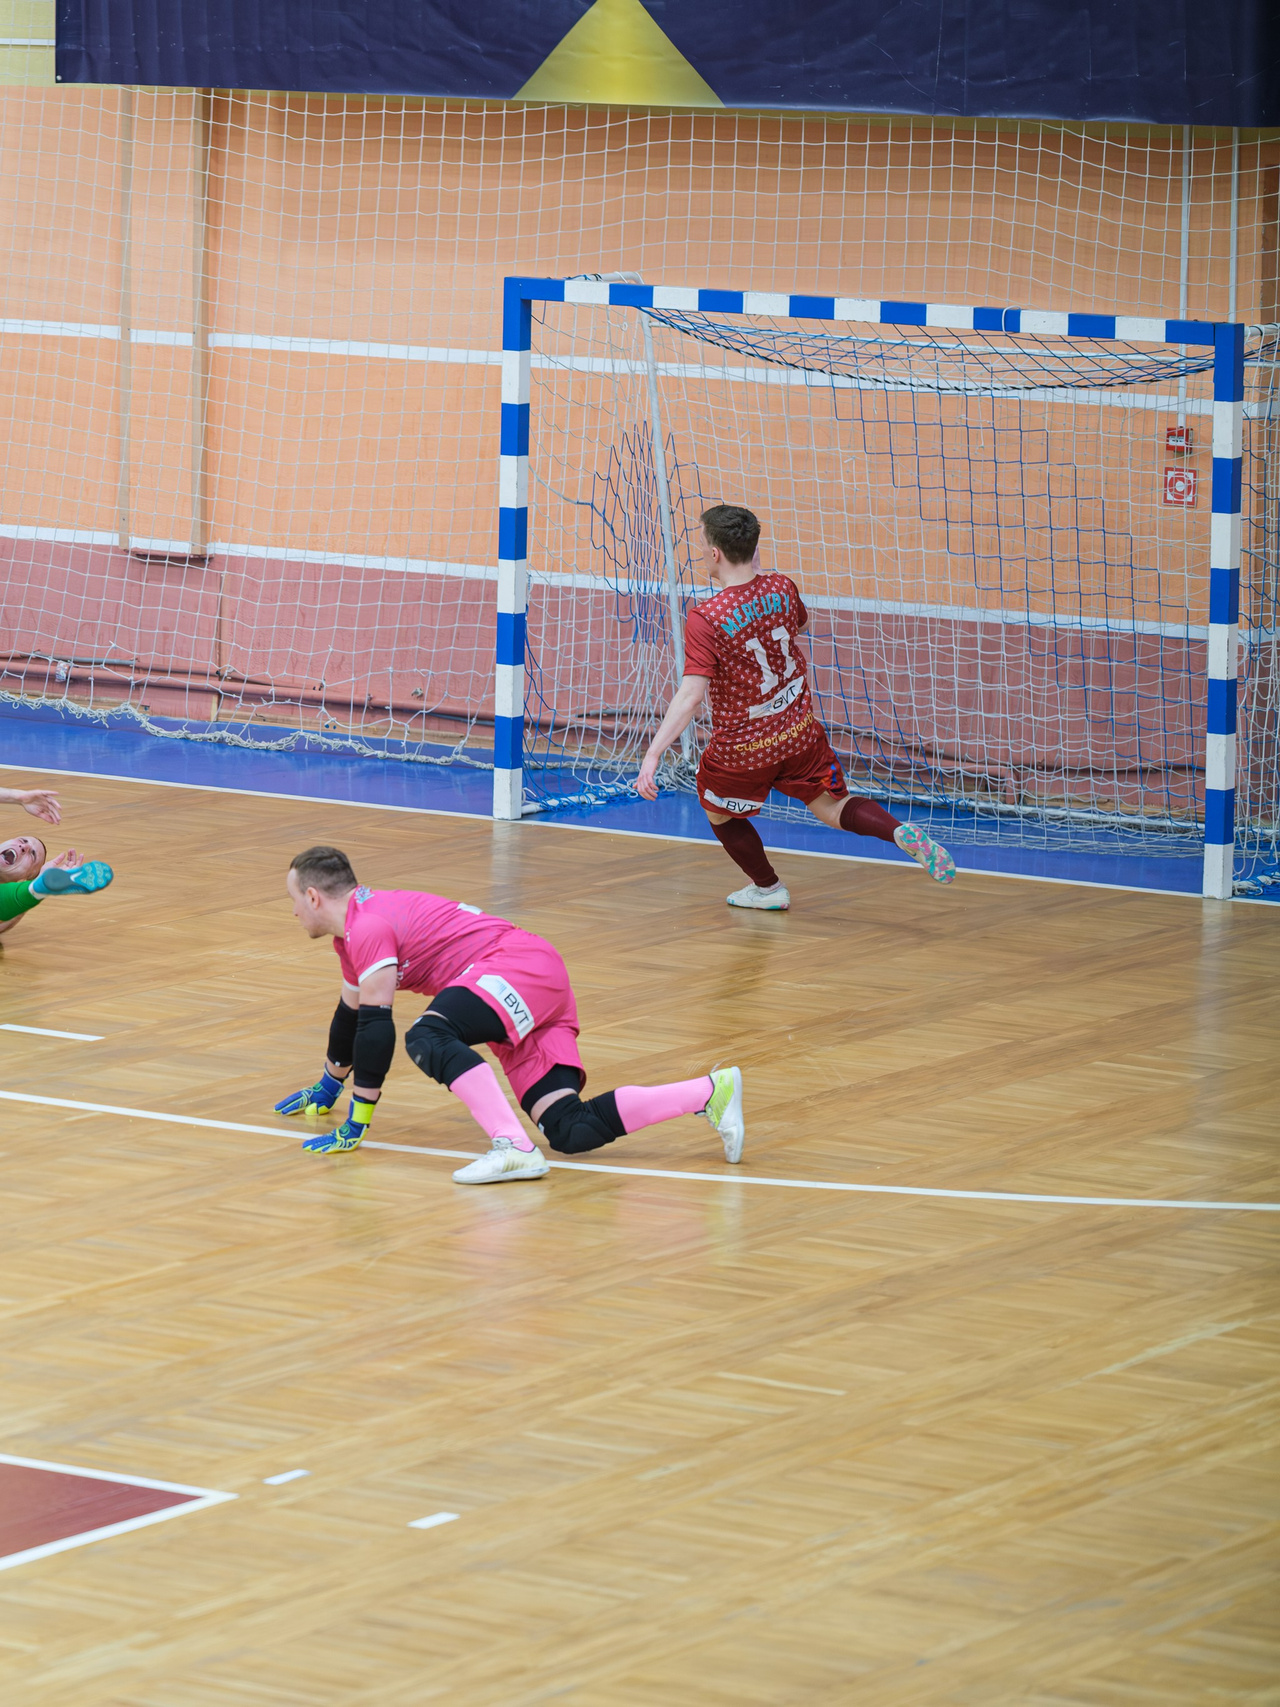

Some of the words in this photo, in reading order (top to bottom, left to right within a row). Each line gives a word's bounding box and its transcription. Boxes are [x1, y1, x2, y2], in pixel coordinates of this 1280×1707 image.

[720, 592, 790, 638] MERCURY
[745, 625, 797, 696] 11
[773, 685, 796, 709] BVT
[726, 800, 757, 812] BVT
[504, 993, 530, 1024] BVT
